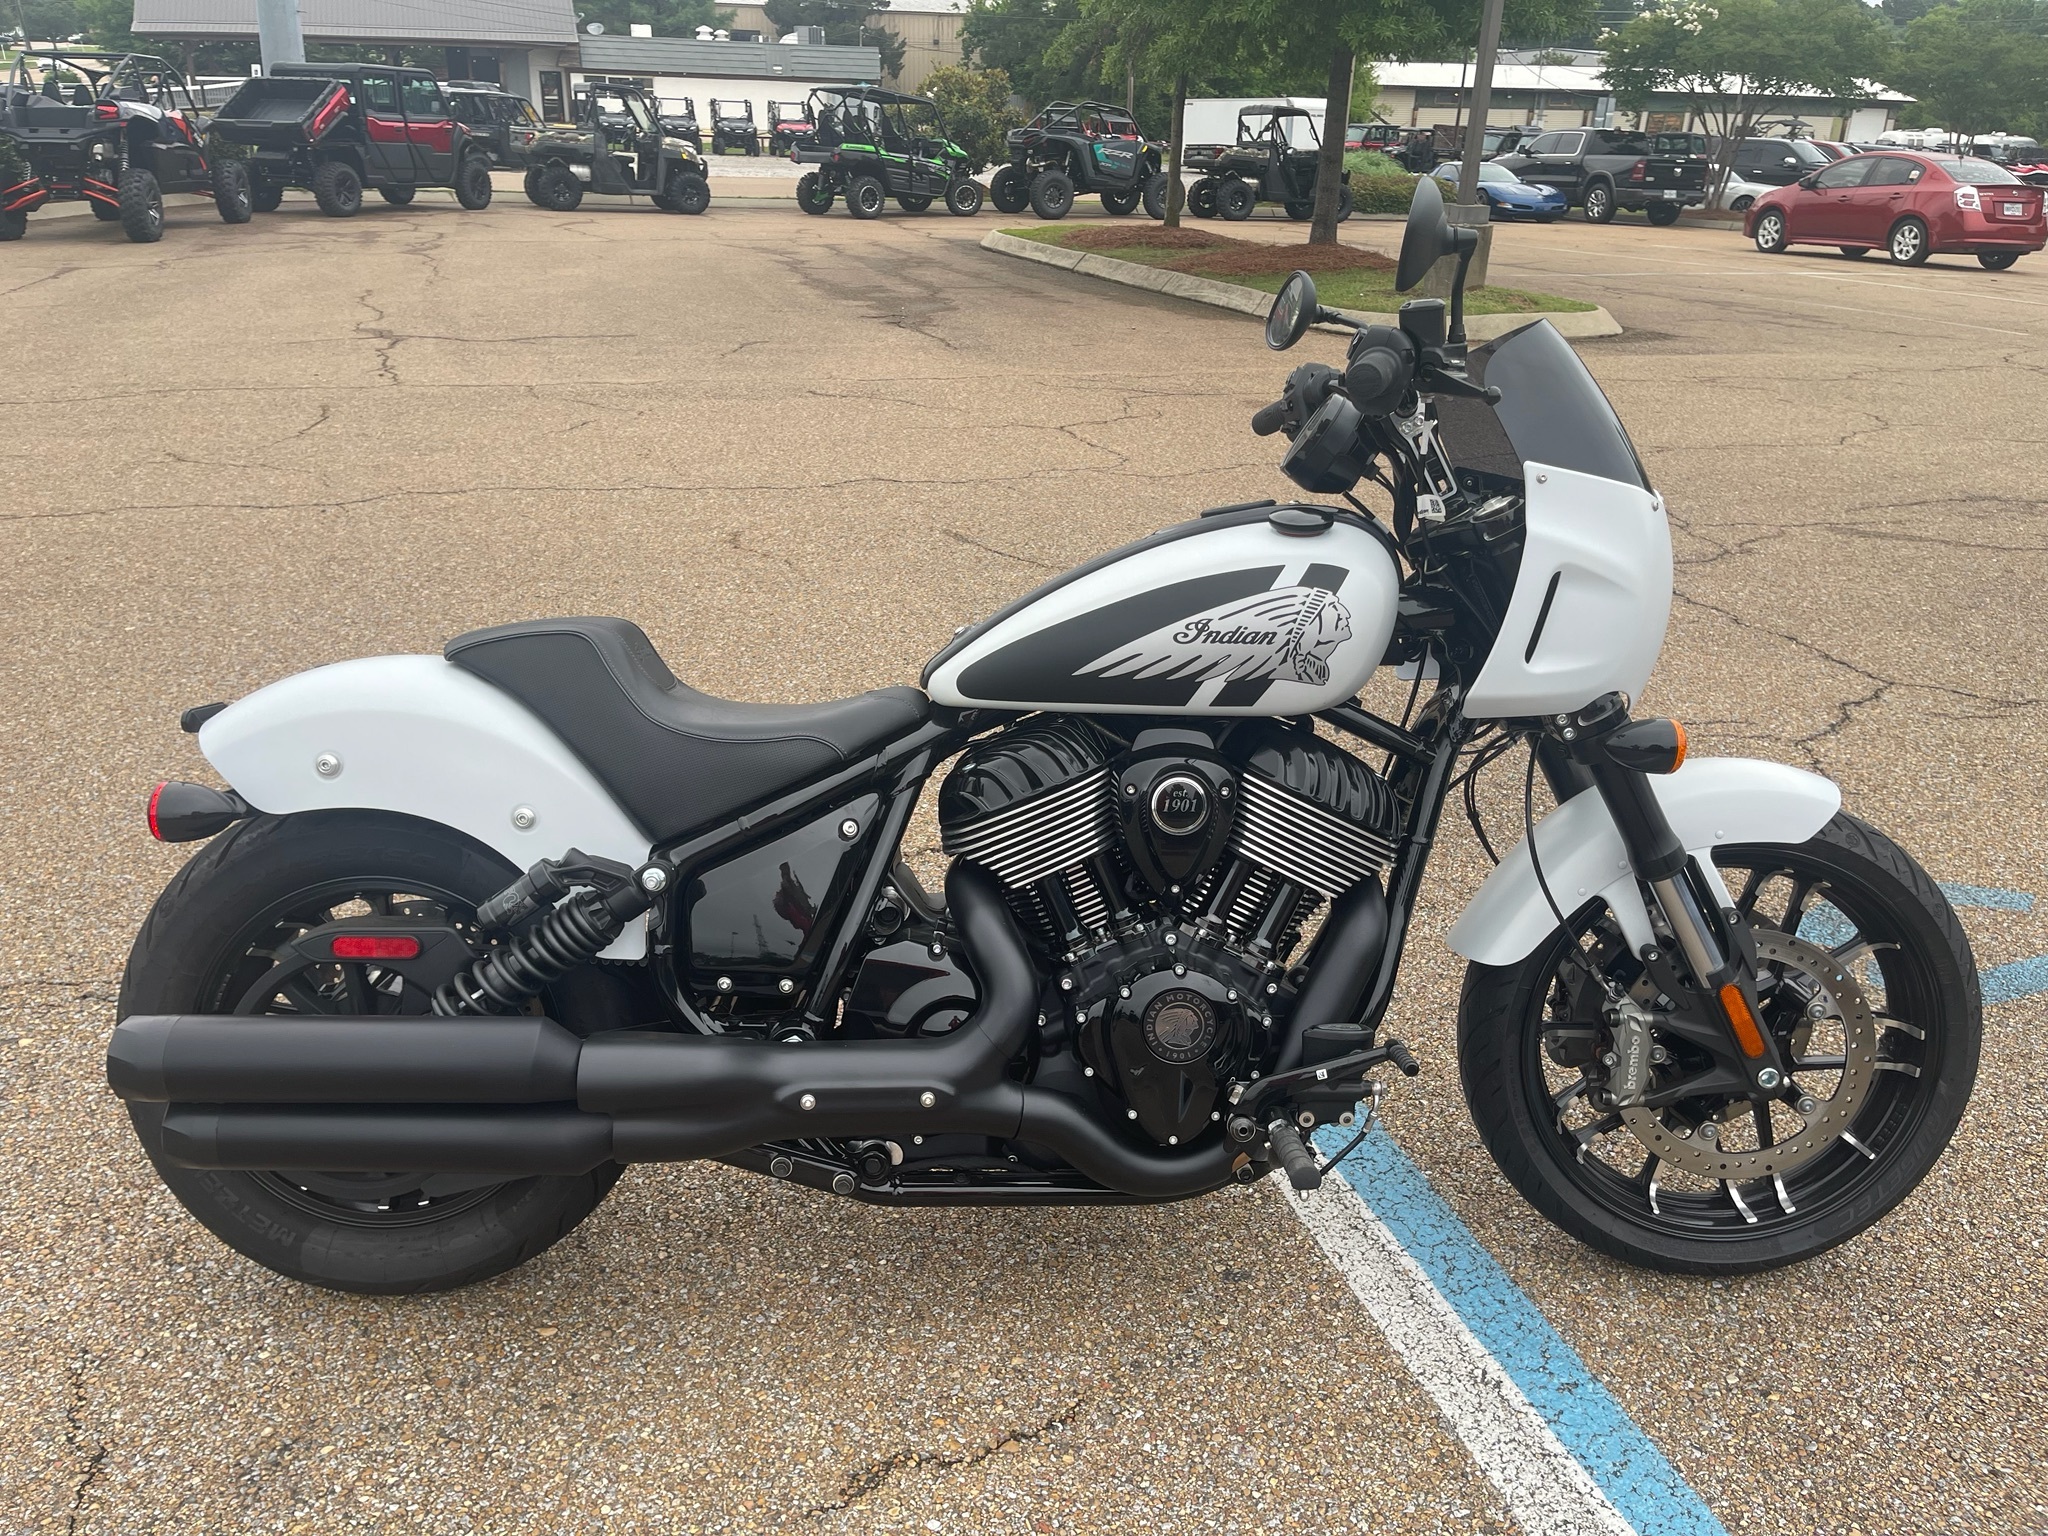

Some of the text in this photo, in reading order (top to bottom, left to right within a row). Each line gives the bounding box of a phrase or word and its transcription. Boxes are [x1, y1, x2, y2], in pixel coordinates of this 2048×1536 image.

[1097, 147, 1134, 159] RZR
[1172, 618, 1278, 645] Indian
[1172, 788, 1188, 797] est.
[1163, 798, 1197, 813] 1901
[1145, 993, 1214, 1048] INDIAN MOTORCYCLE
[1165, 1051, 1192, 1060] 1901
[1624, 1035, 1641, 1090] brembo
